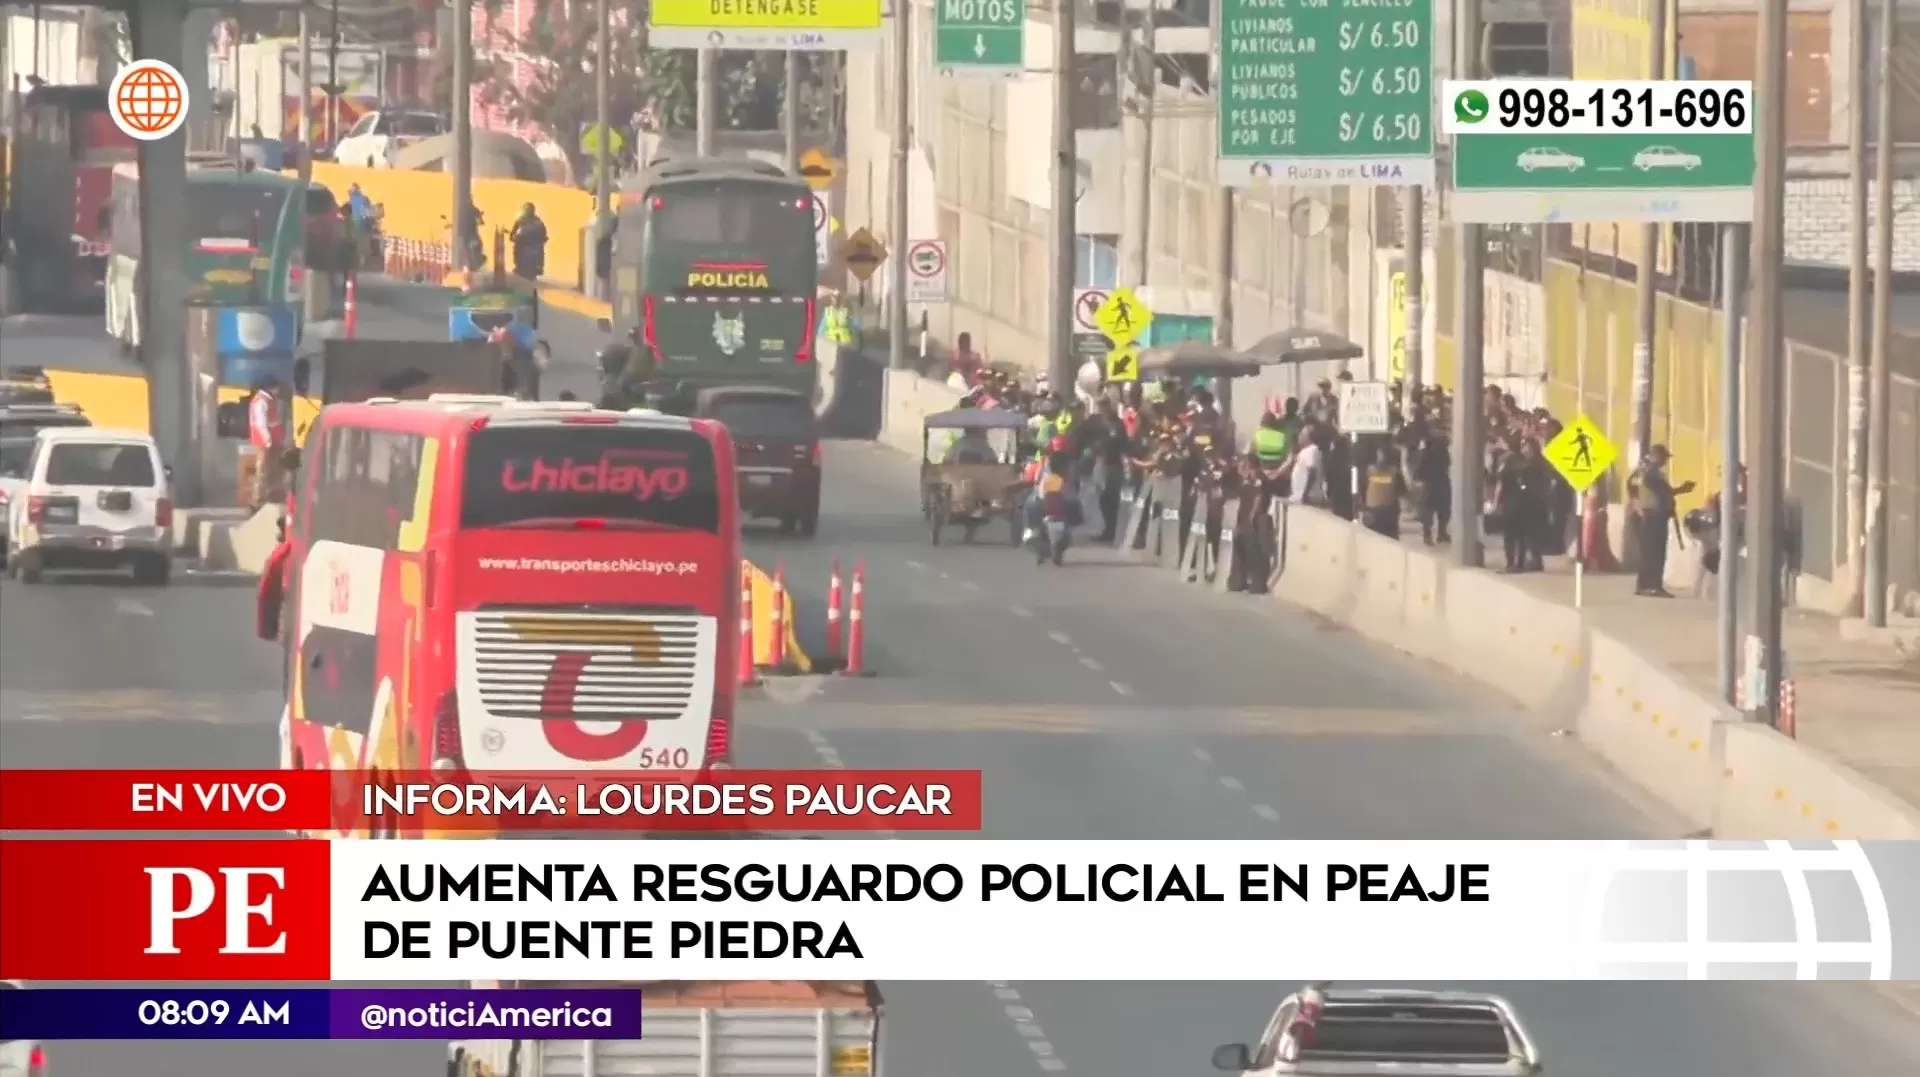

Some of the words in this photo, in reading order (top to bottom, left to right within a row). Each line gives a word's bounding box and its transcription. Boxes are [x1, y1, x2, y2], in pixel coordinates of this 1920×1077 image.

[945, 0, 1016, 22] MOTOS
[1231, 17, 1294, 34] LIVIANOS
[1339, 21, 1364, 50] S/
[1370, 20, 1419, 48] 6.50
[1231, 37, 1316, 53] PARTICULAR
[1231, 63, 1296, 80] LIVIANOS
[1339, 67, 1364, 96] S/
[1371, 66, 1421, 95] 6.50
[1231, 109, 1297, 125] PESADOS
[1339, 112, 1365, 142] S/
[1372, 113, 1421, 142] 6.50
[1231, 129, 1260, 145] POR
[1270, 128, 1296, 145] EJE
[1360, 164, 1403, 179] LIMA
[478, 556, 698, 576] www.transporteschiclayo.pe
[639, 746, 689, 769] 540
